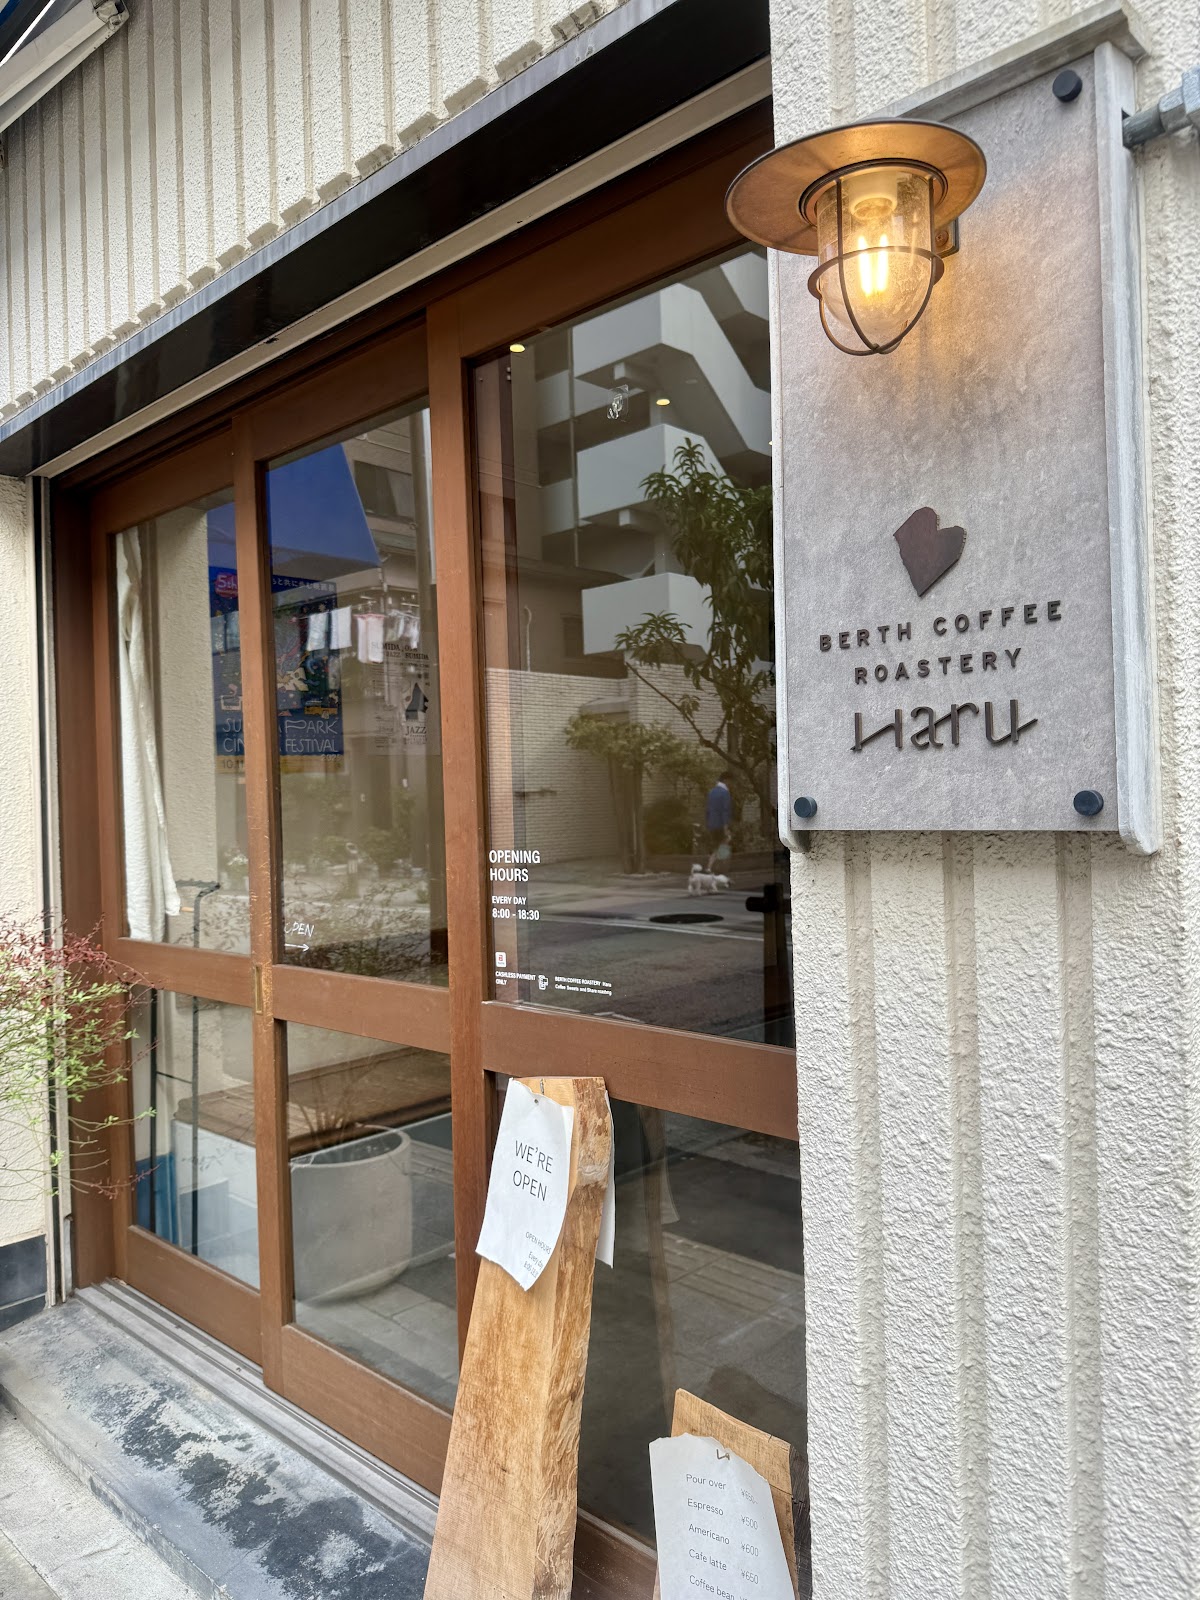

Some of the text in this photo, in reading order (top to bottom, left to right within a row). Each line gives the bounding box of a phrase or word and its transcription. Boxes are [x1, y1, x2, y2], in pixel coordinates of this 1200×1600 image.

[819, 600, 1062, 651] BERTH COFFEE
[854, 648, 1021, 685] ROASTERY
[285, 719, 338, 735] PARK
[850, 699, 1038, 751] Haru
[285, 738, 338, 753] FESTIVAL
[489, 849, 541, 864] OPENING
[490, 868, 529, 882] HOURS
[491, 896, 527, 906] EVERY DAY
[492, 908, 511, 919] 8:00
[517, 909, 540, 921] 18:30
[515, 1140, 553, 1174] WE’RE
[513, 1170, 547, 1201] OPEN
[686, 1473, 706, 1485] Pour
[708, 1479, 726, 1490] over
[687, 1498, 758, 1530] Espresso ¥500
[688, 1523, 759, 1557] Americano ¥600
[688, 1548, 759, 1584] Cafe latte ¥650
[689, 1574, 715, 1593] Coffee
